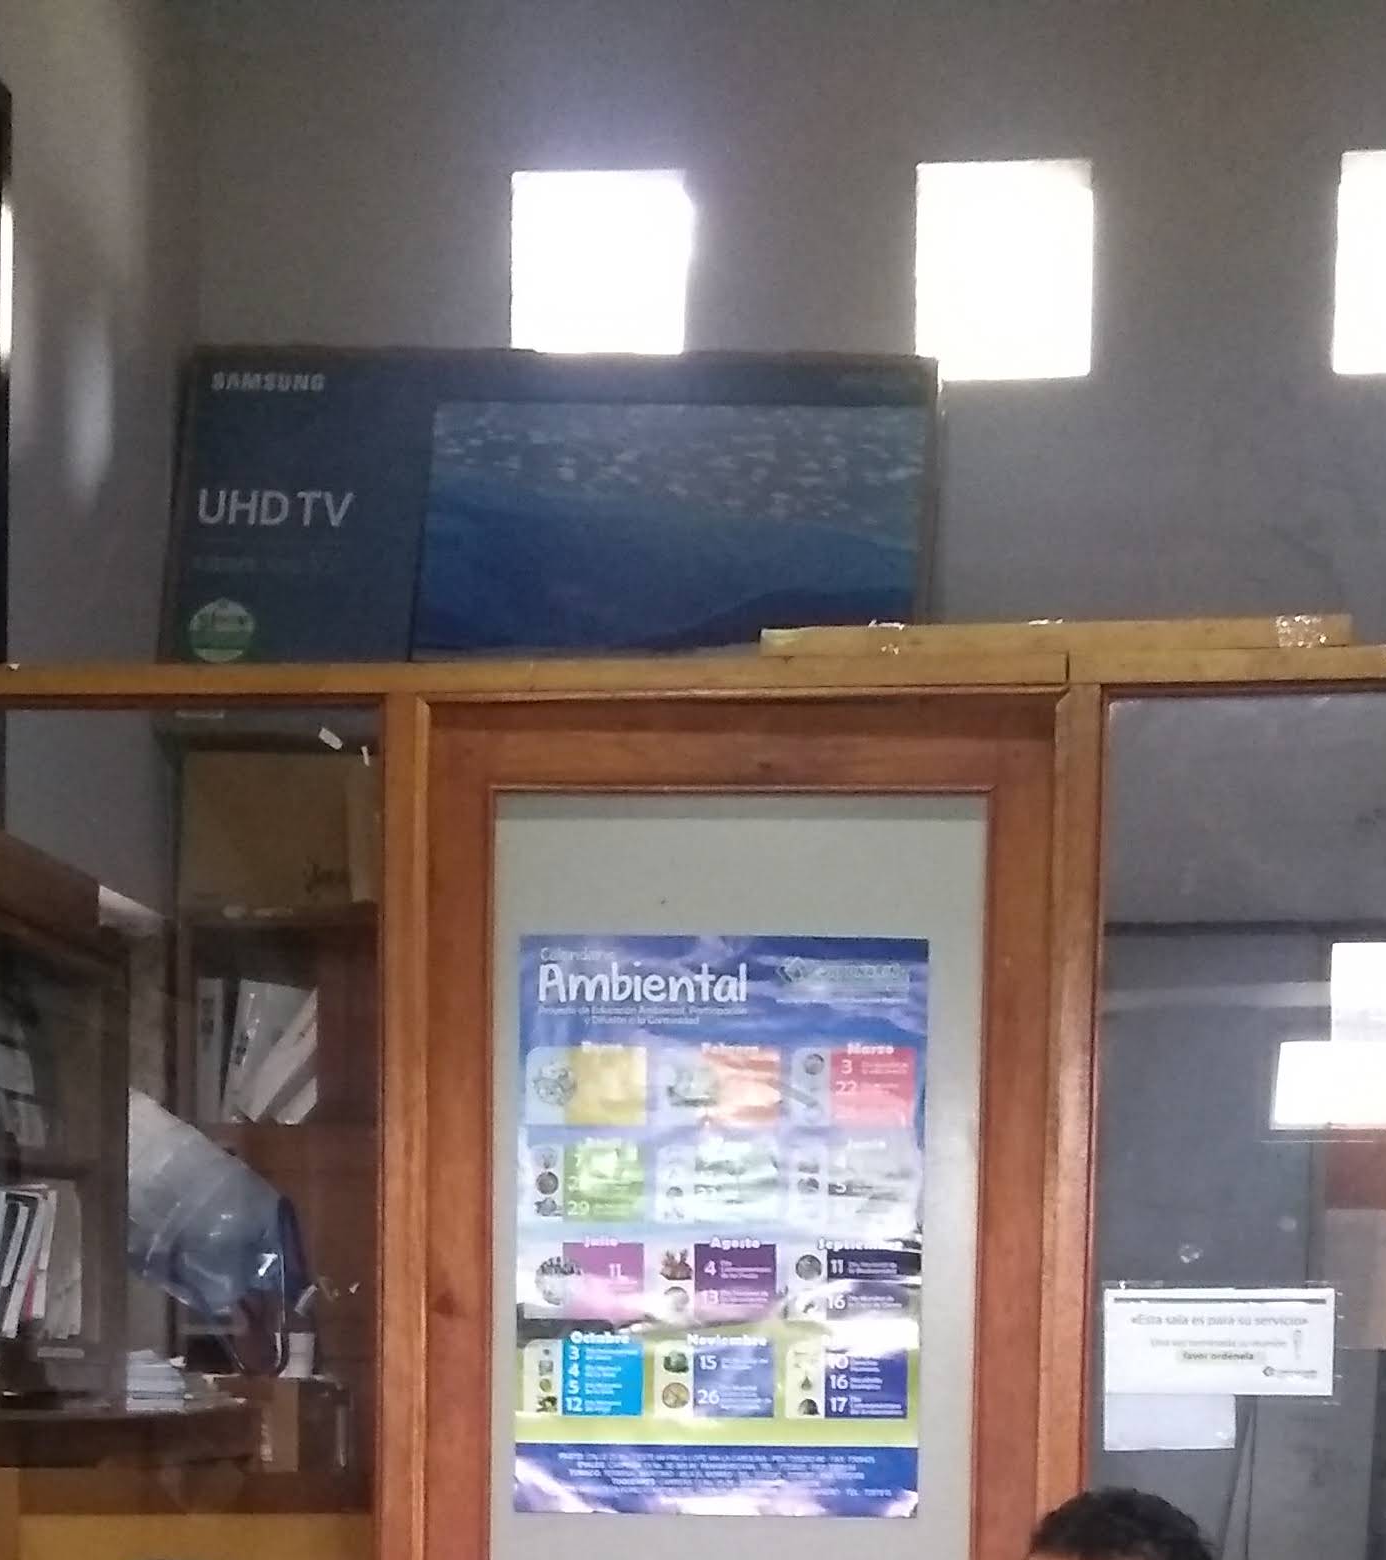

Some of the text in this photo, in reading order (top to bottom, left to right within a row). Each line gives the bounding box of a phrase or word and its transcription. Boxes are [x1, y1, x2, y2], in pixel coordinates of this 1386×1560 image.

[212, 371, 325, 392] SAMSUNG
[198, 488, 354, 527] UHD TV
[539, 962, 747, 1003] Ambiental
[704, 1260, 716, 1275] 4
[687, 1333, 767, 1346] Noviembre
[700, 1355, 717, 1370] 15
[1182, 1351, 1208, 1361] favor
[830, 1374, 848, 1390] 16
[566, 1397, 583, 1412] 12
[697, 1390, 720, 1404] 26
[830, 1397, 848, 1413] 17
